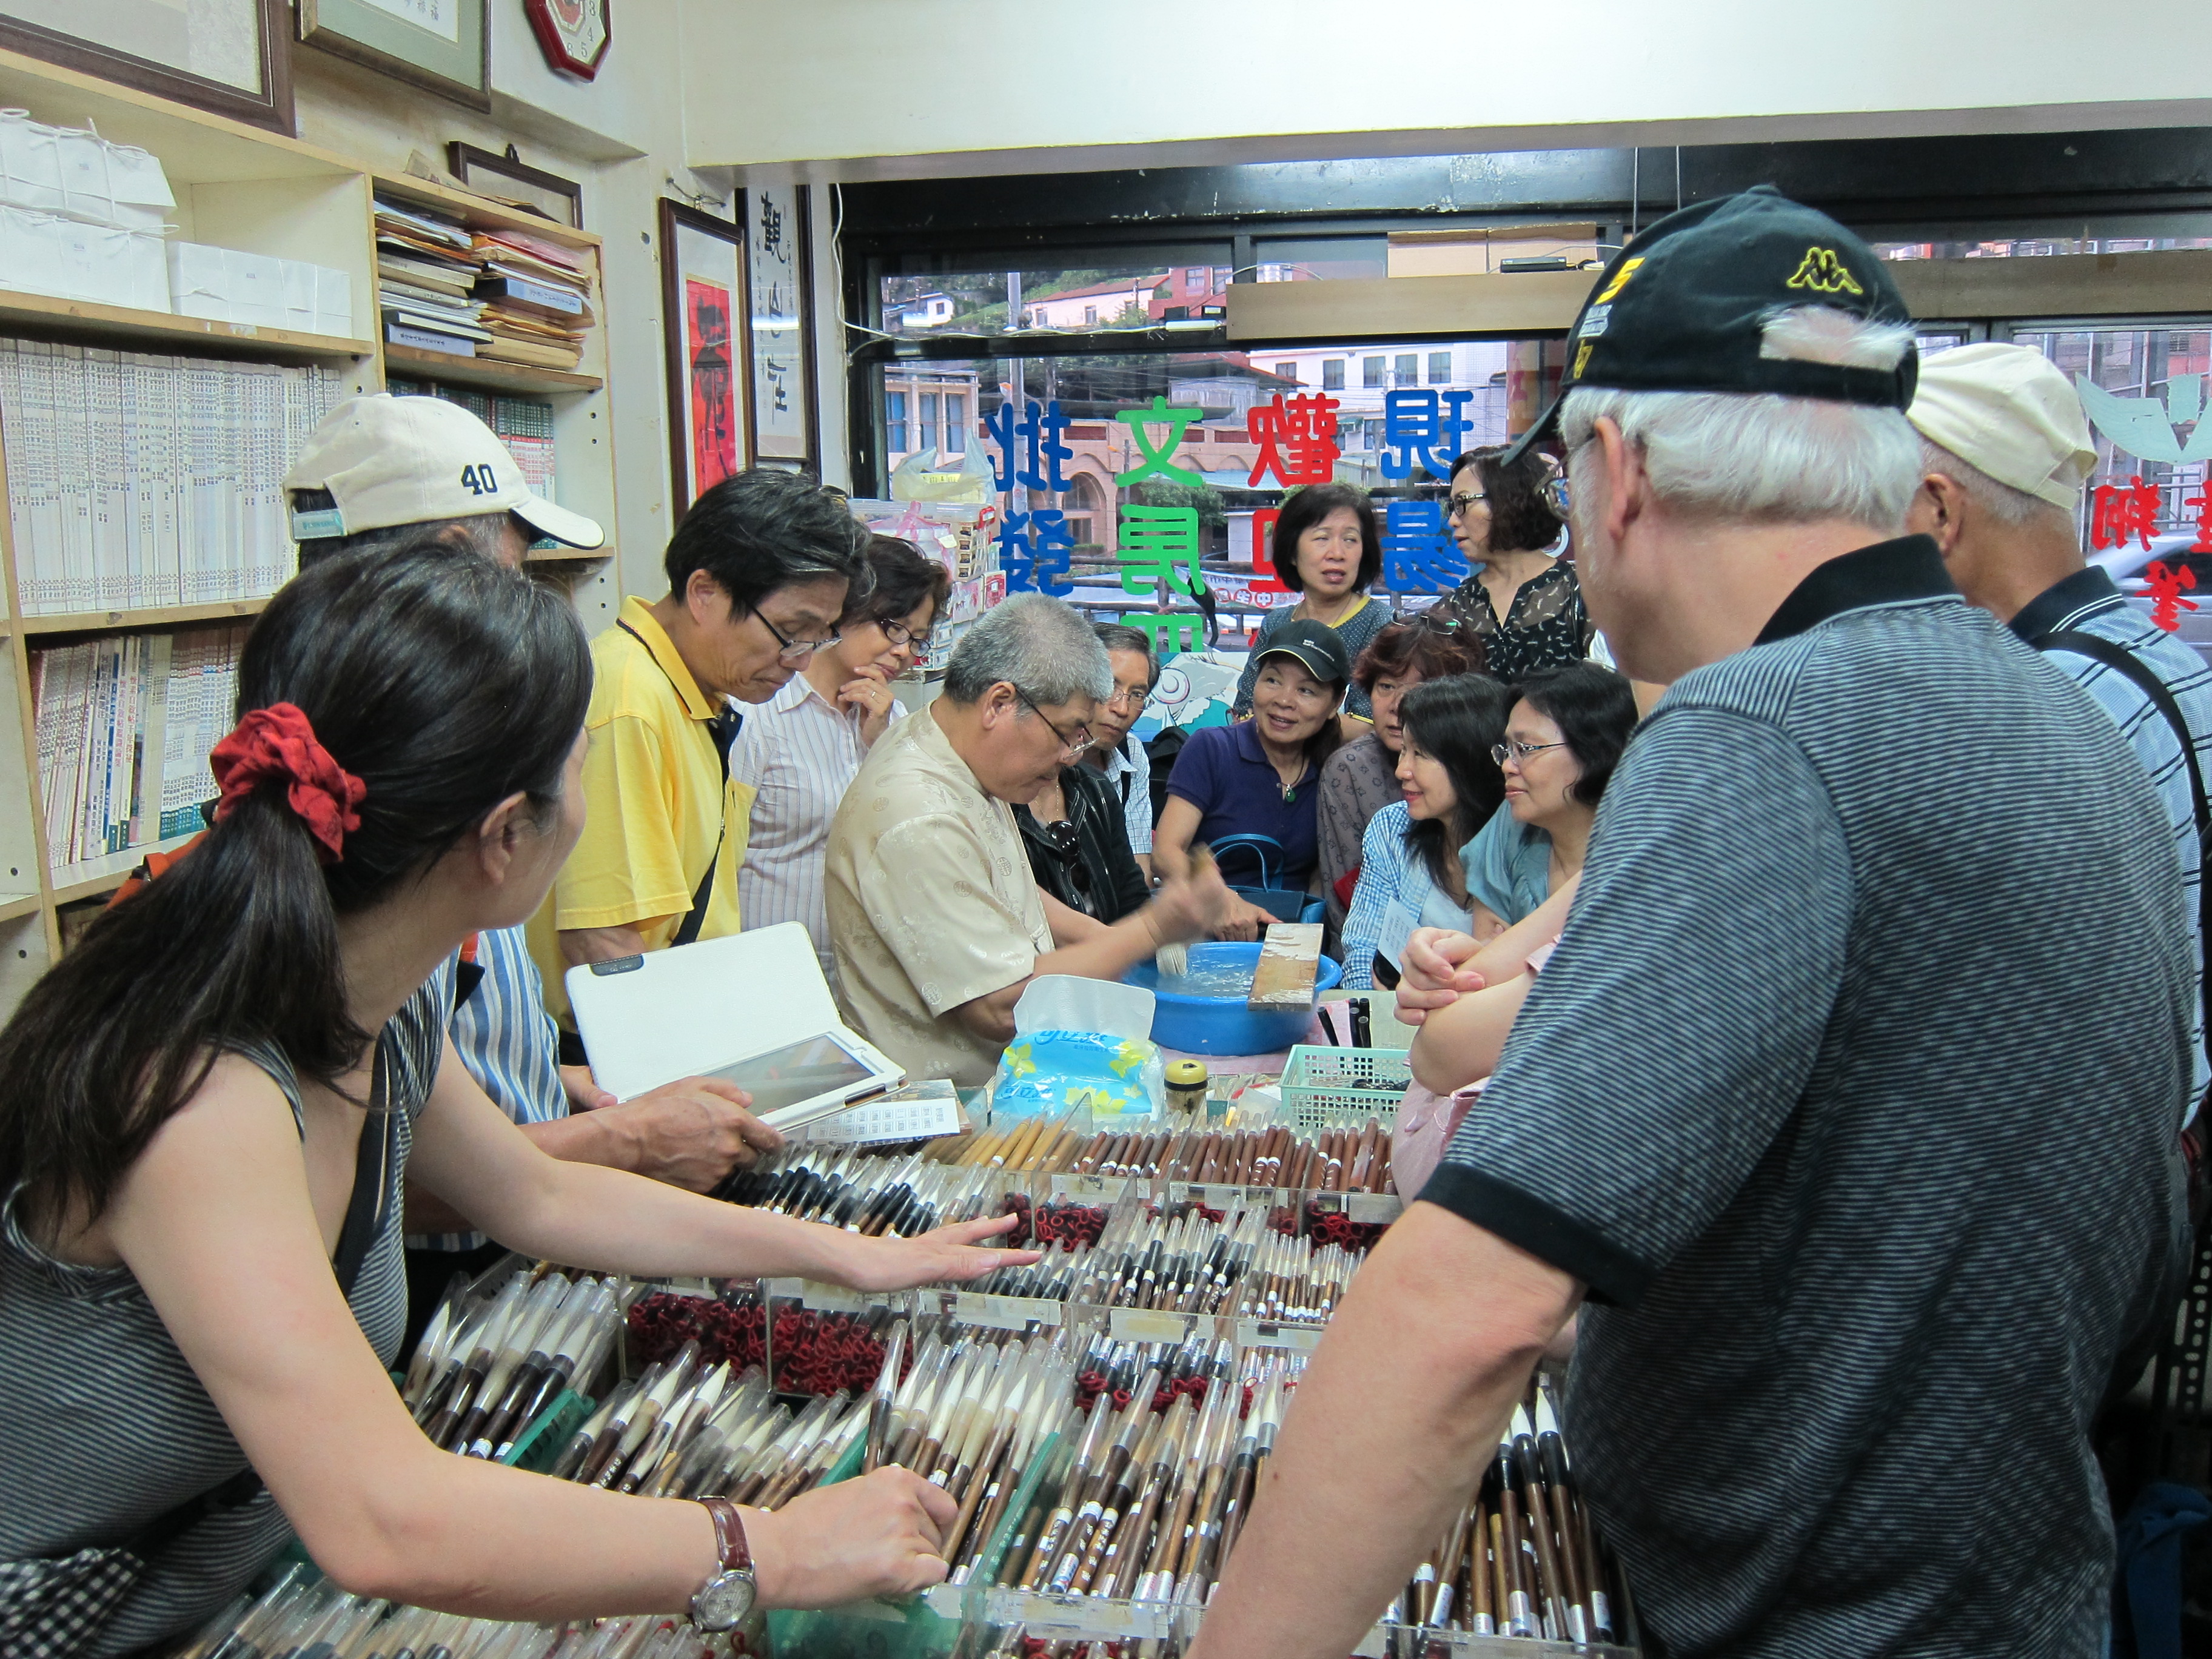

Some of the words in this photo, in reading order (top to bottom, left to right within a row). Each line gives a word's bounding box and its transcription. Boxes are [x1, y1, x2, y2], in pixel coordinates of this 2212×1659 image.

[587, 27, 594, 42] 4
[581, 42, 588, 58] 5
[461, 463, 498, 495] 40
